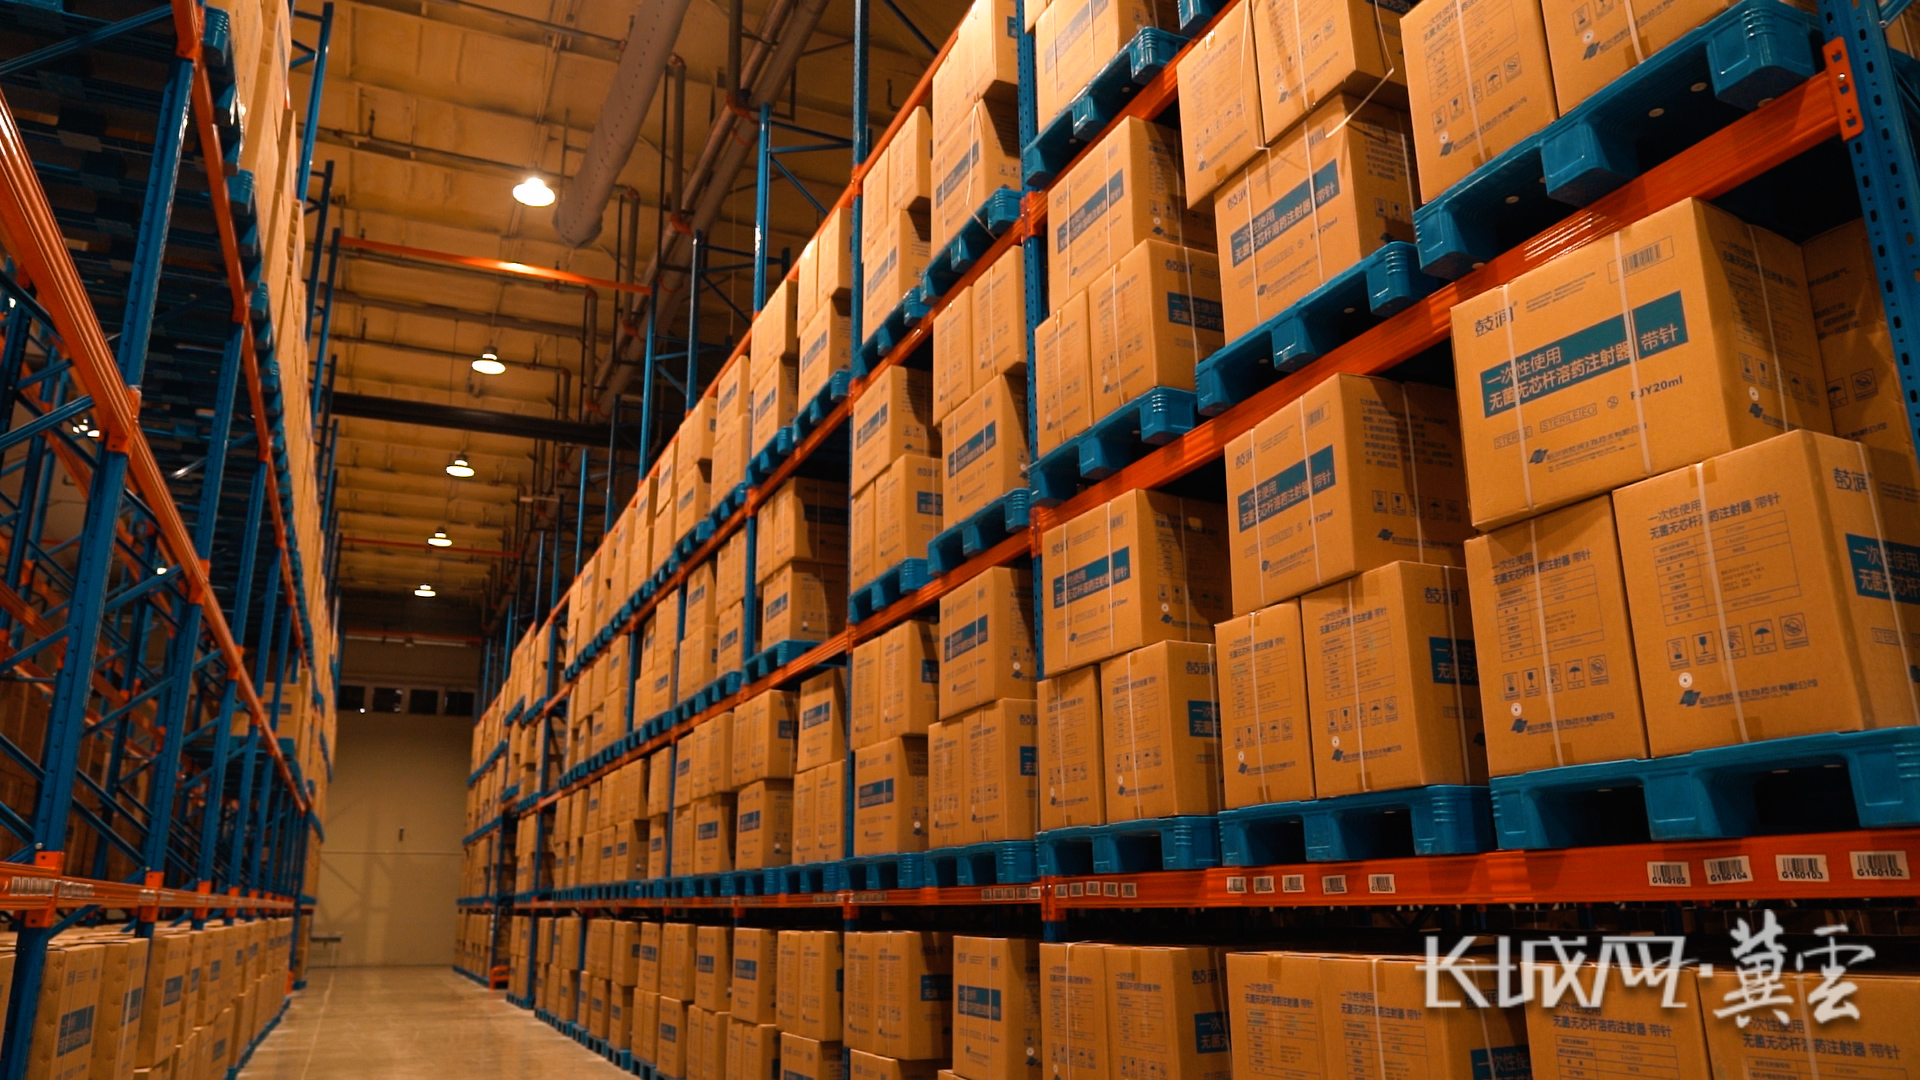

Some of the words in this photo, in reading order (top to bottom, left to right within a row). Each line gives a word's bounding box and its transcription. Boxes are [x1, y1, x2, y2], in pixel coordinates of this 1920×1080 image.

[1474, 305, 1515, 337] 鼓润
[1486, 346, 1562, 386] 一次性使用
[1489, 339, 1632, 412] 无菌无芯杆溶药注射器
[1640, 323, 1679, 352] 带针
[1495, 427, 1531, 449] STERIE
[1647, 499, 1701, 523] 一次性使用
[1754, 492, 1781, 509] 带针
[1781, 871, 1824, 880] G160103
[1856, 868, 1904, 878] G160102
